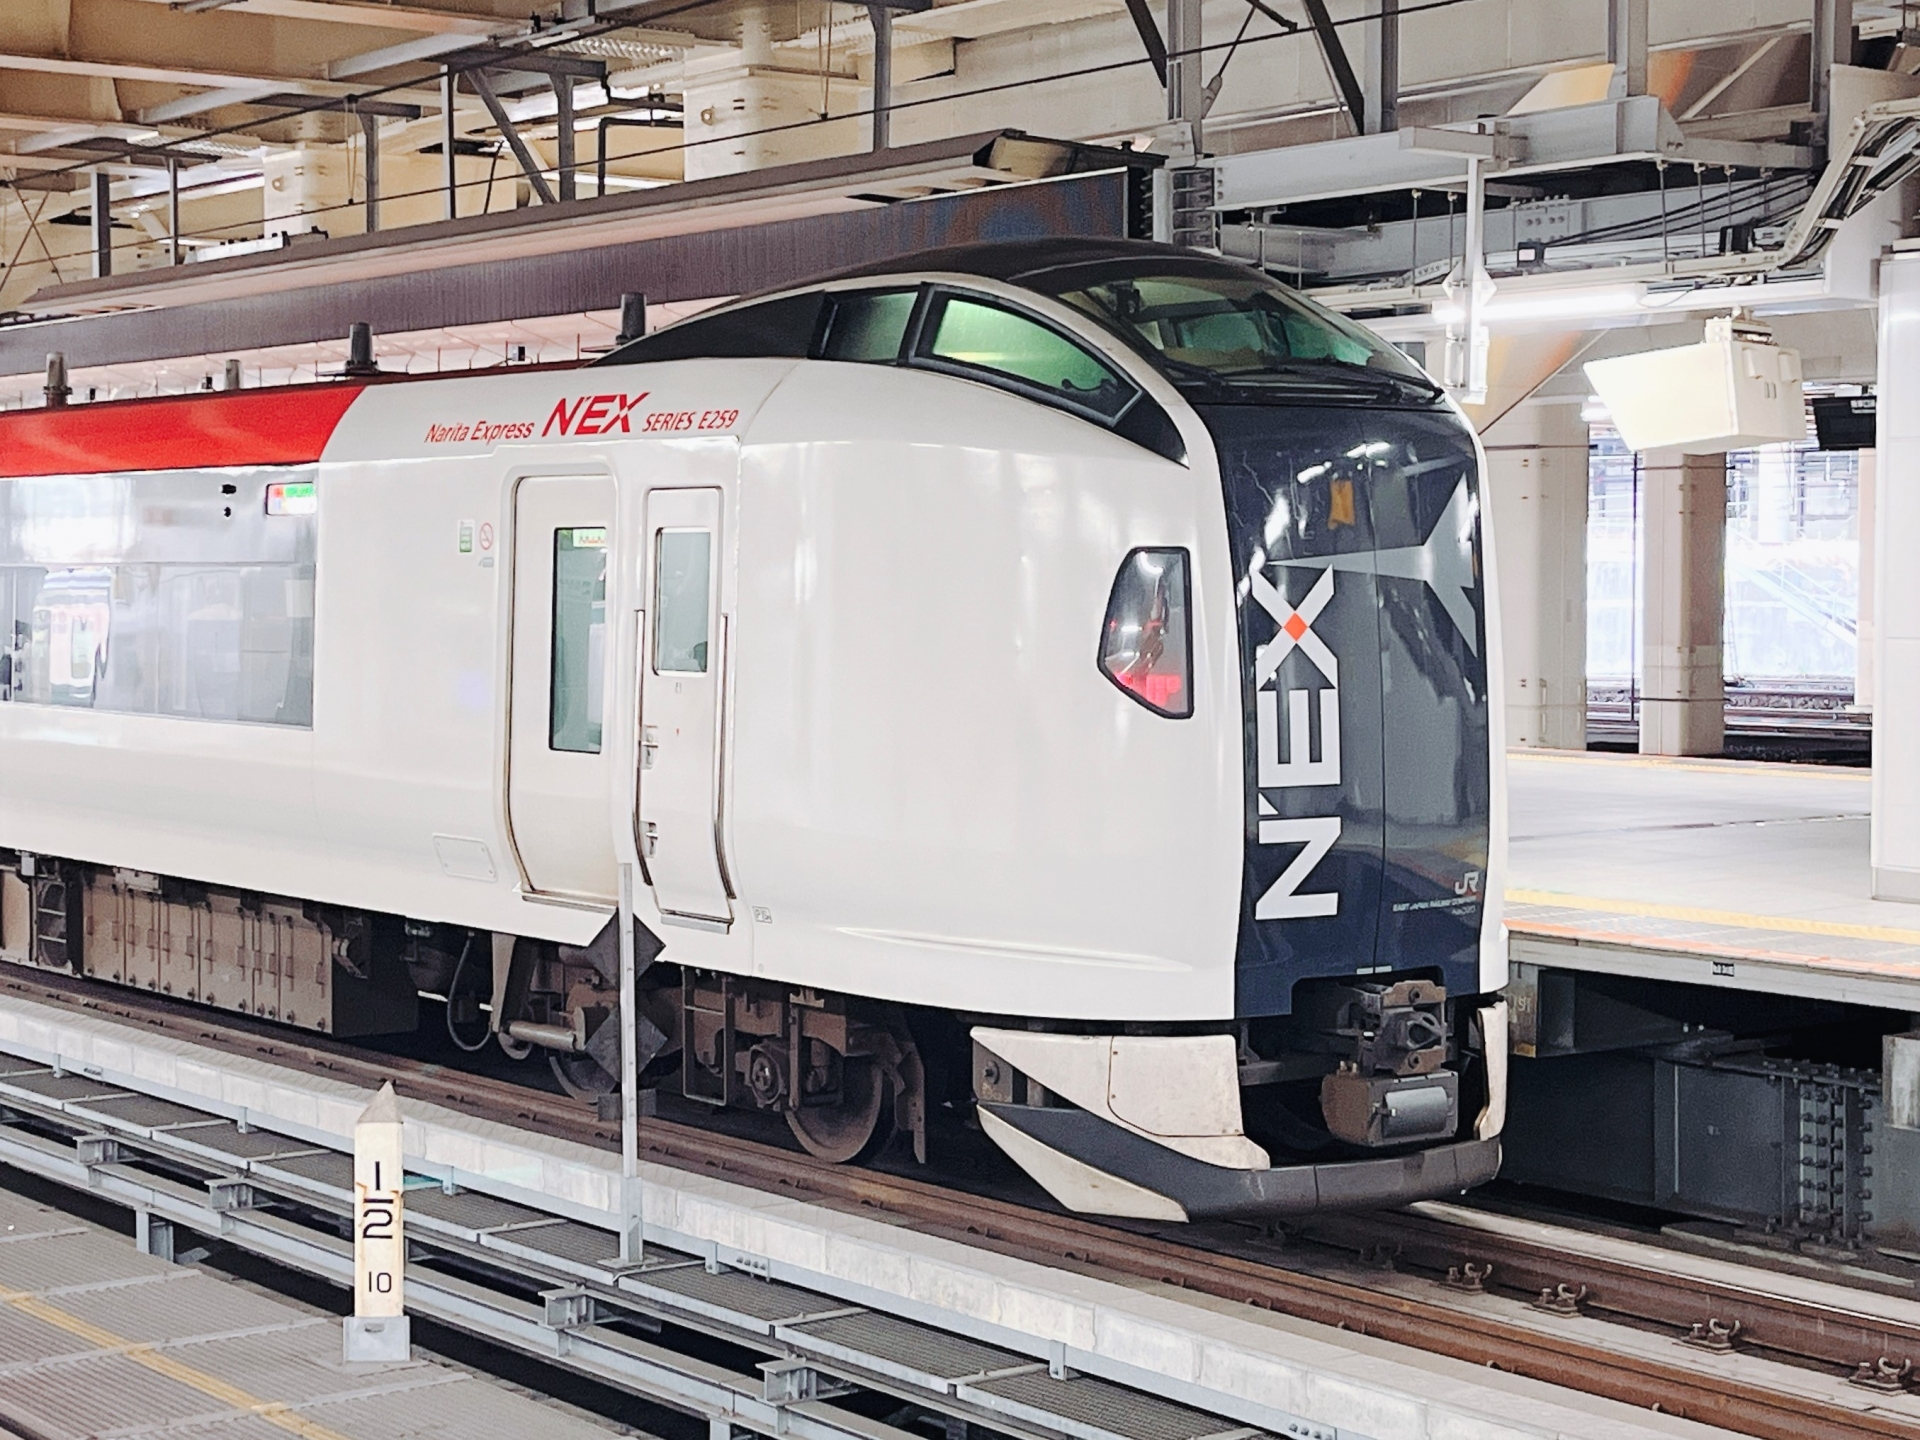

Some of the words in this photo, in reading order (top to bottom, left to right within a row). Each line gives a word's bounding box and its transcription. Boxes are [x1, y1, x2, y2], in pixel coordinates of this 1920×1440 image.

[424, 422, 470, 443] Narita
[470, 420, 535, 446] Express
[642, 411, 697, 432] SERIES
[698, 409, 739, 430] E259
[1454, 871, 1479, 895] JR
[368, 1271, 392, 1293] 10
